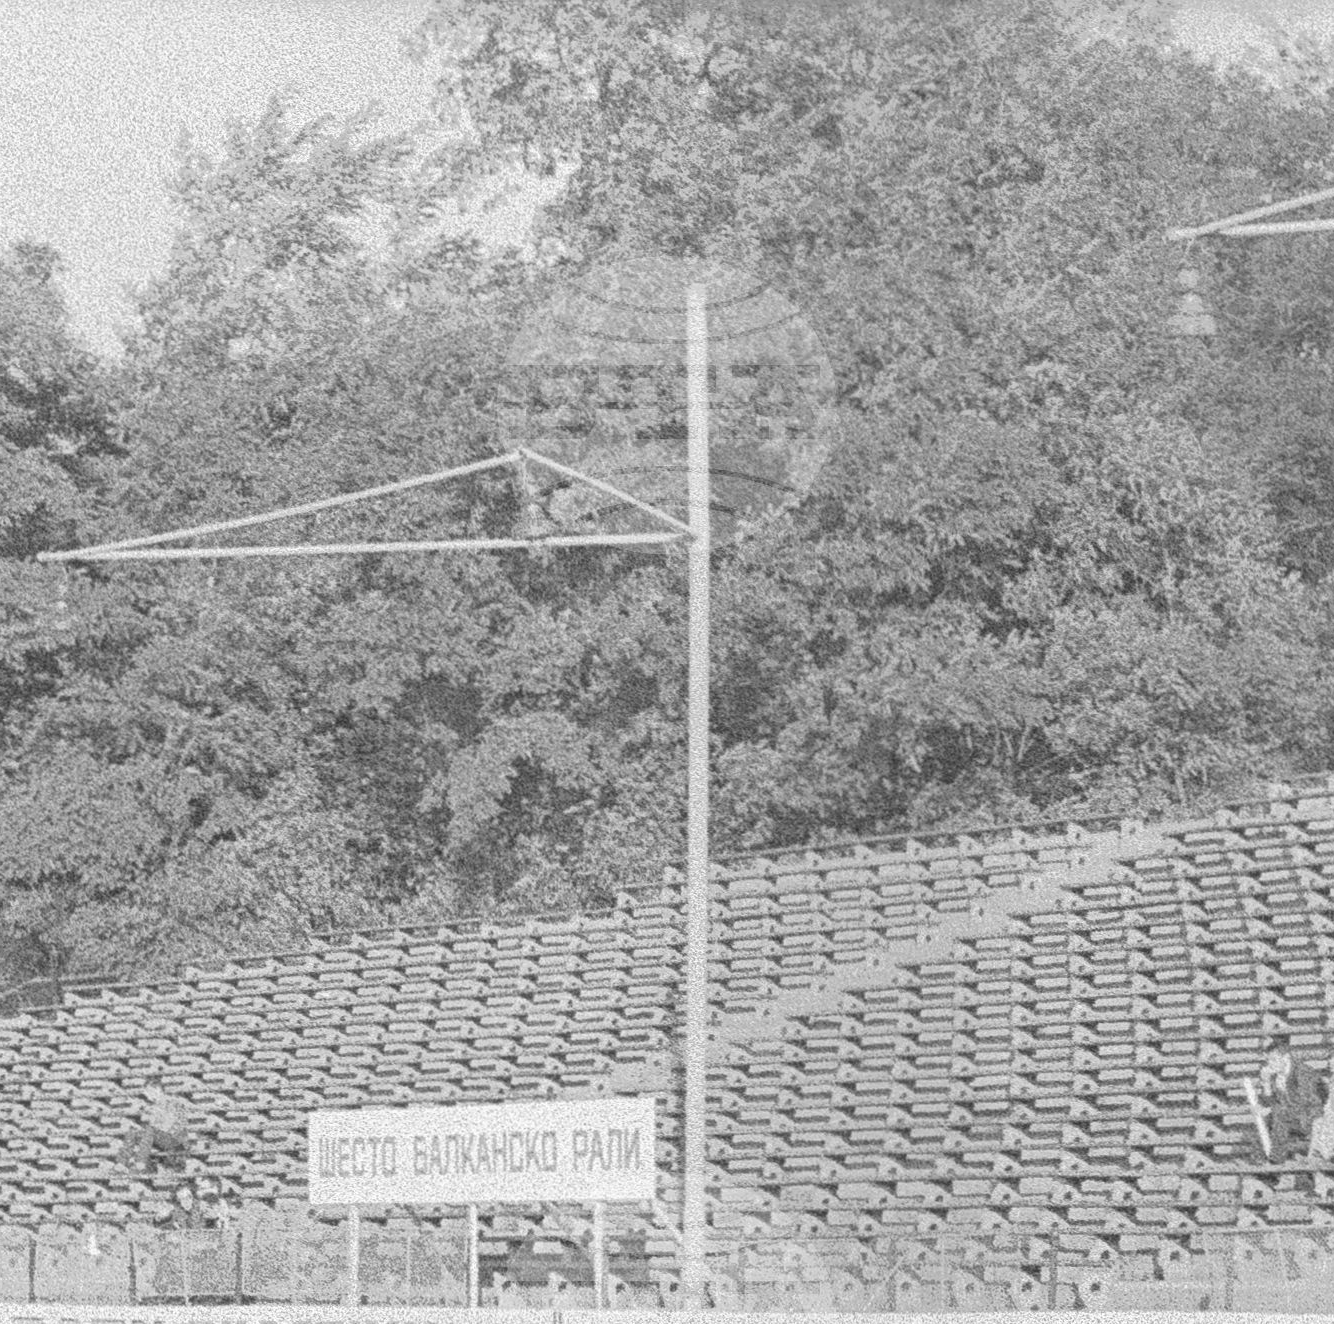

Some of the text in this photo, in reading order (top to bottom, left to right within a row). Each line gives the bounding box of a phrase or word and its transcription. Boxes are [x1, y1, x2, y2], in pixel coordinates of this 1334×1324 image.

[318, 1127, 643, 1179] ШЕСТО БАЛКАНСКО РАЛИ
